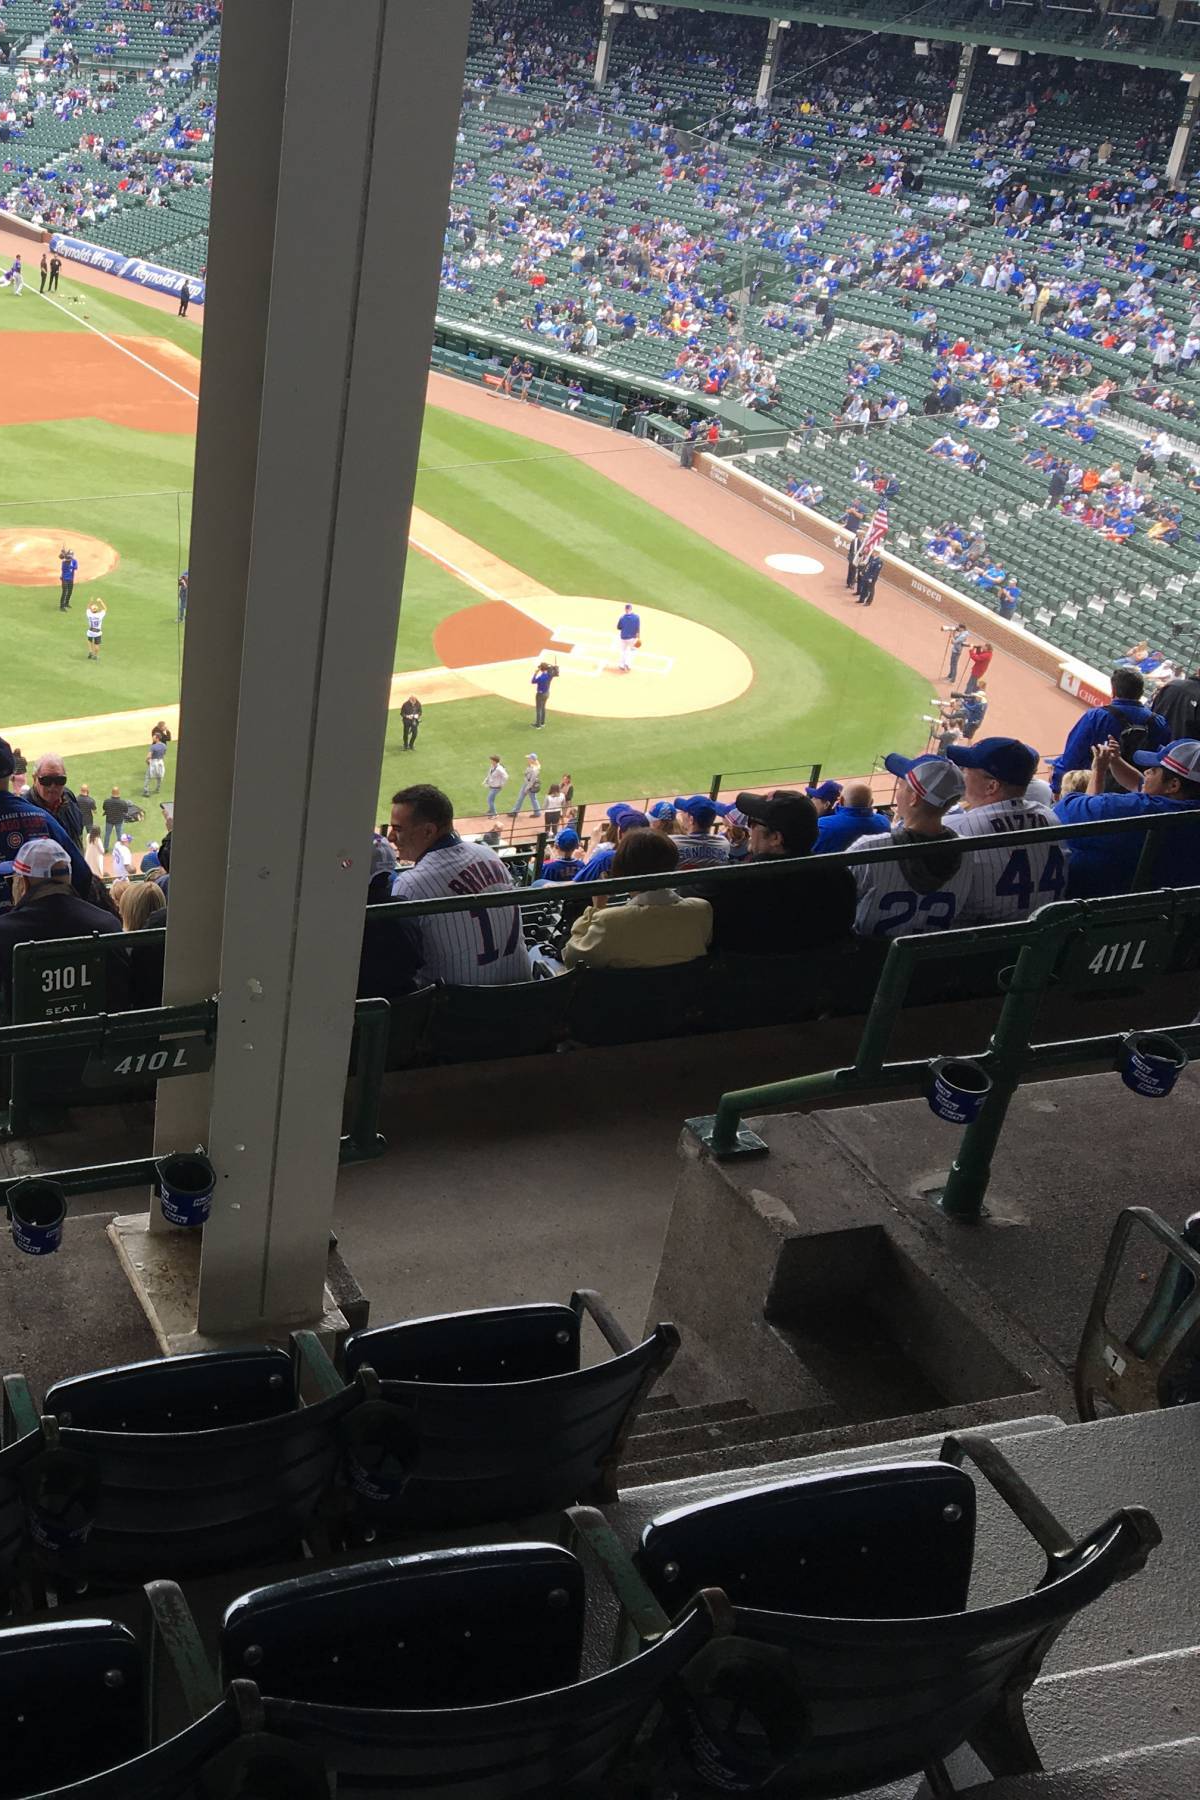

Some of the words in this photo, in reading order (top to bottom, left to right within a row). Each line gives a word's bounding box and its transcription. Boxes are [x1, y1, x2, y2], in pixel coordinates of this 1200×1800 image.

[55, 240, 91, 264] Reynolds
[90, 251, 115, 271] Wrap
[131, 264, 177, 288] Reynolds
[911, 580, 942, 603] nuveen
[995, 847, 1065, 909] 44
[874, 890, 956, 934] 23
[1088, 942, 1132, 975] 411
[1131, 939, 1147, 969] L
[41, 966, 76, 993] 310
[81, 964, 92, 987] L
[45, 1004, 78, 1016] SEAT
[113, 1052, 169, 1075] 410
[172, 1048, 189, 1068] L
